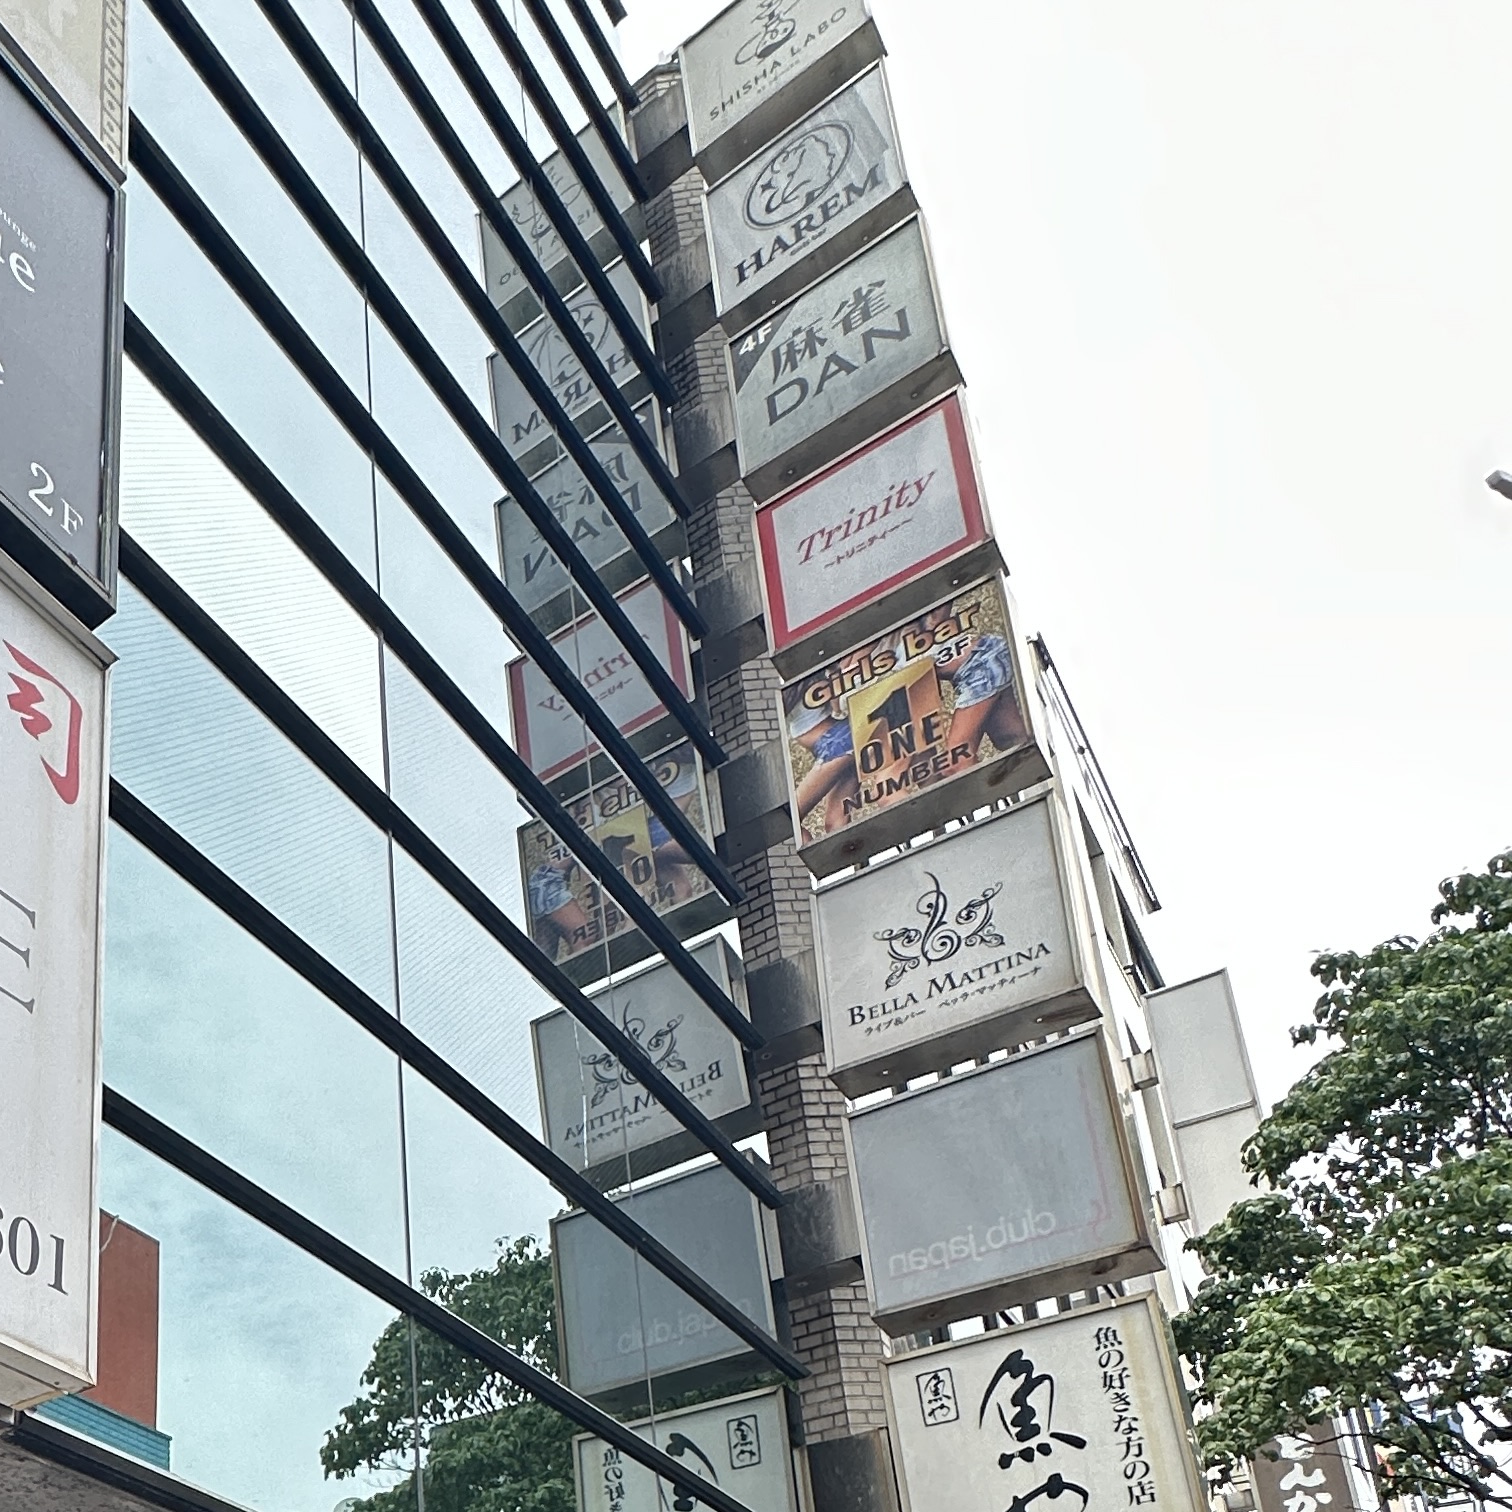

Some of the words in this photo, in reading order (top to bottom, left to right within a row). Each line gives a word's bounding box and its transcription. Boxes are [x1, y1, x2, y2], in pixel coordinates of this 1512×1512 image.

[710, 61, 781, 121] SHISHA
[790, 7, 846, 56] LABO
[733, 163, 882, 287] HAREM
[738, 321, 773, 356] 4F
[767, 306, 911, 426] DAN
[771, 279, 889, 385] 麻雀
[27, 462, 83, 536] 2F
[797, 463, 937, 566] Trinity
[803, 651, 897, 709] Girls
[904, 602, 981, 659] bar
[936, 636, 972, 666] 3F
[842, 743, 973, 816] NUMBER
[860, 712, 942, 775] ONE
[848, 993, 918, 1047] BELLA
[925, 942, 1051, 1020] MATTINA
[1093, 1326, 1157, 1507] 魚の好きな方の店
